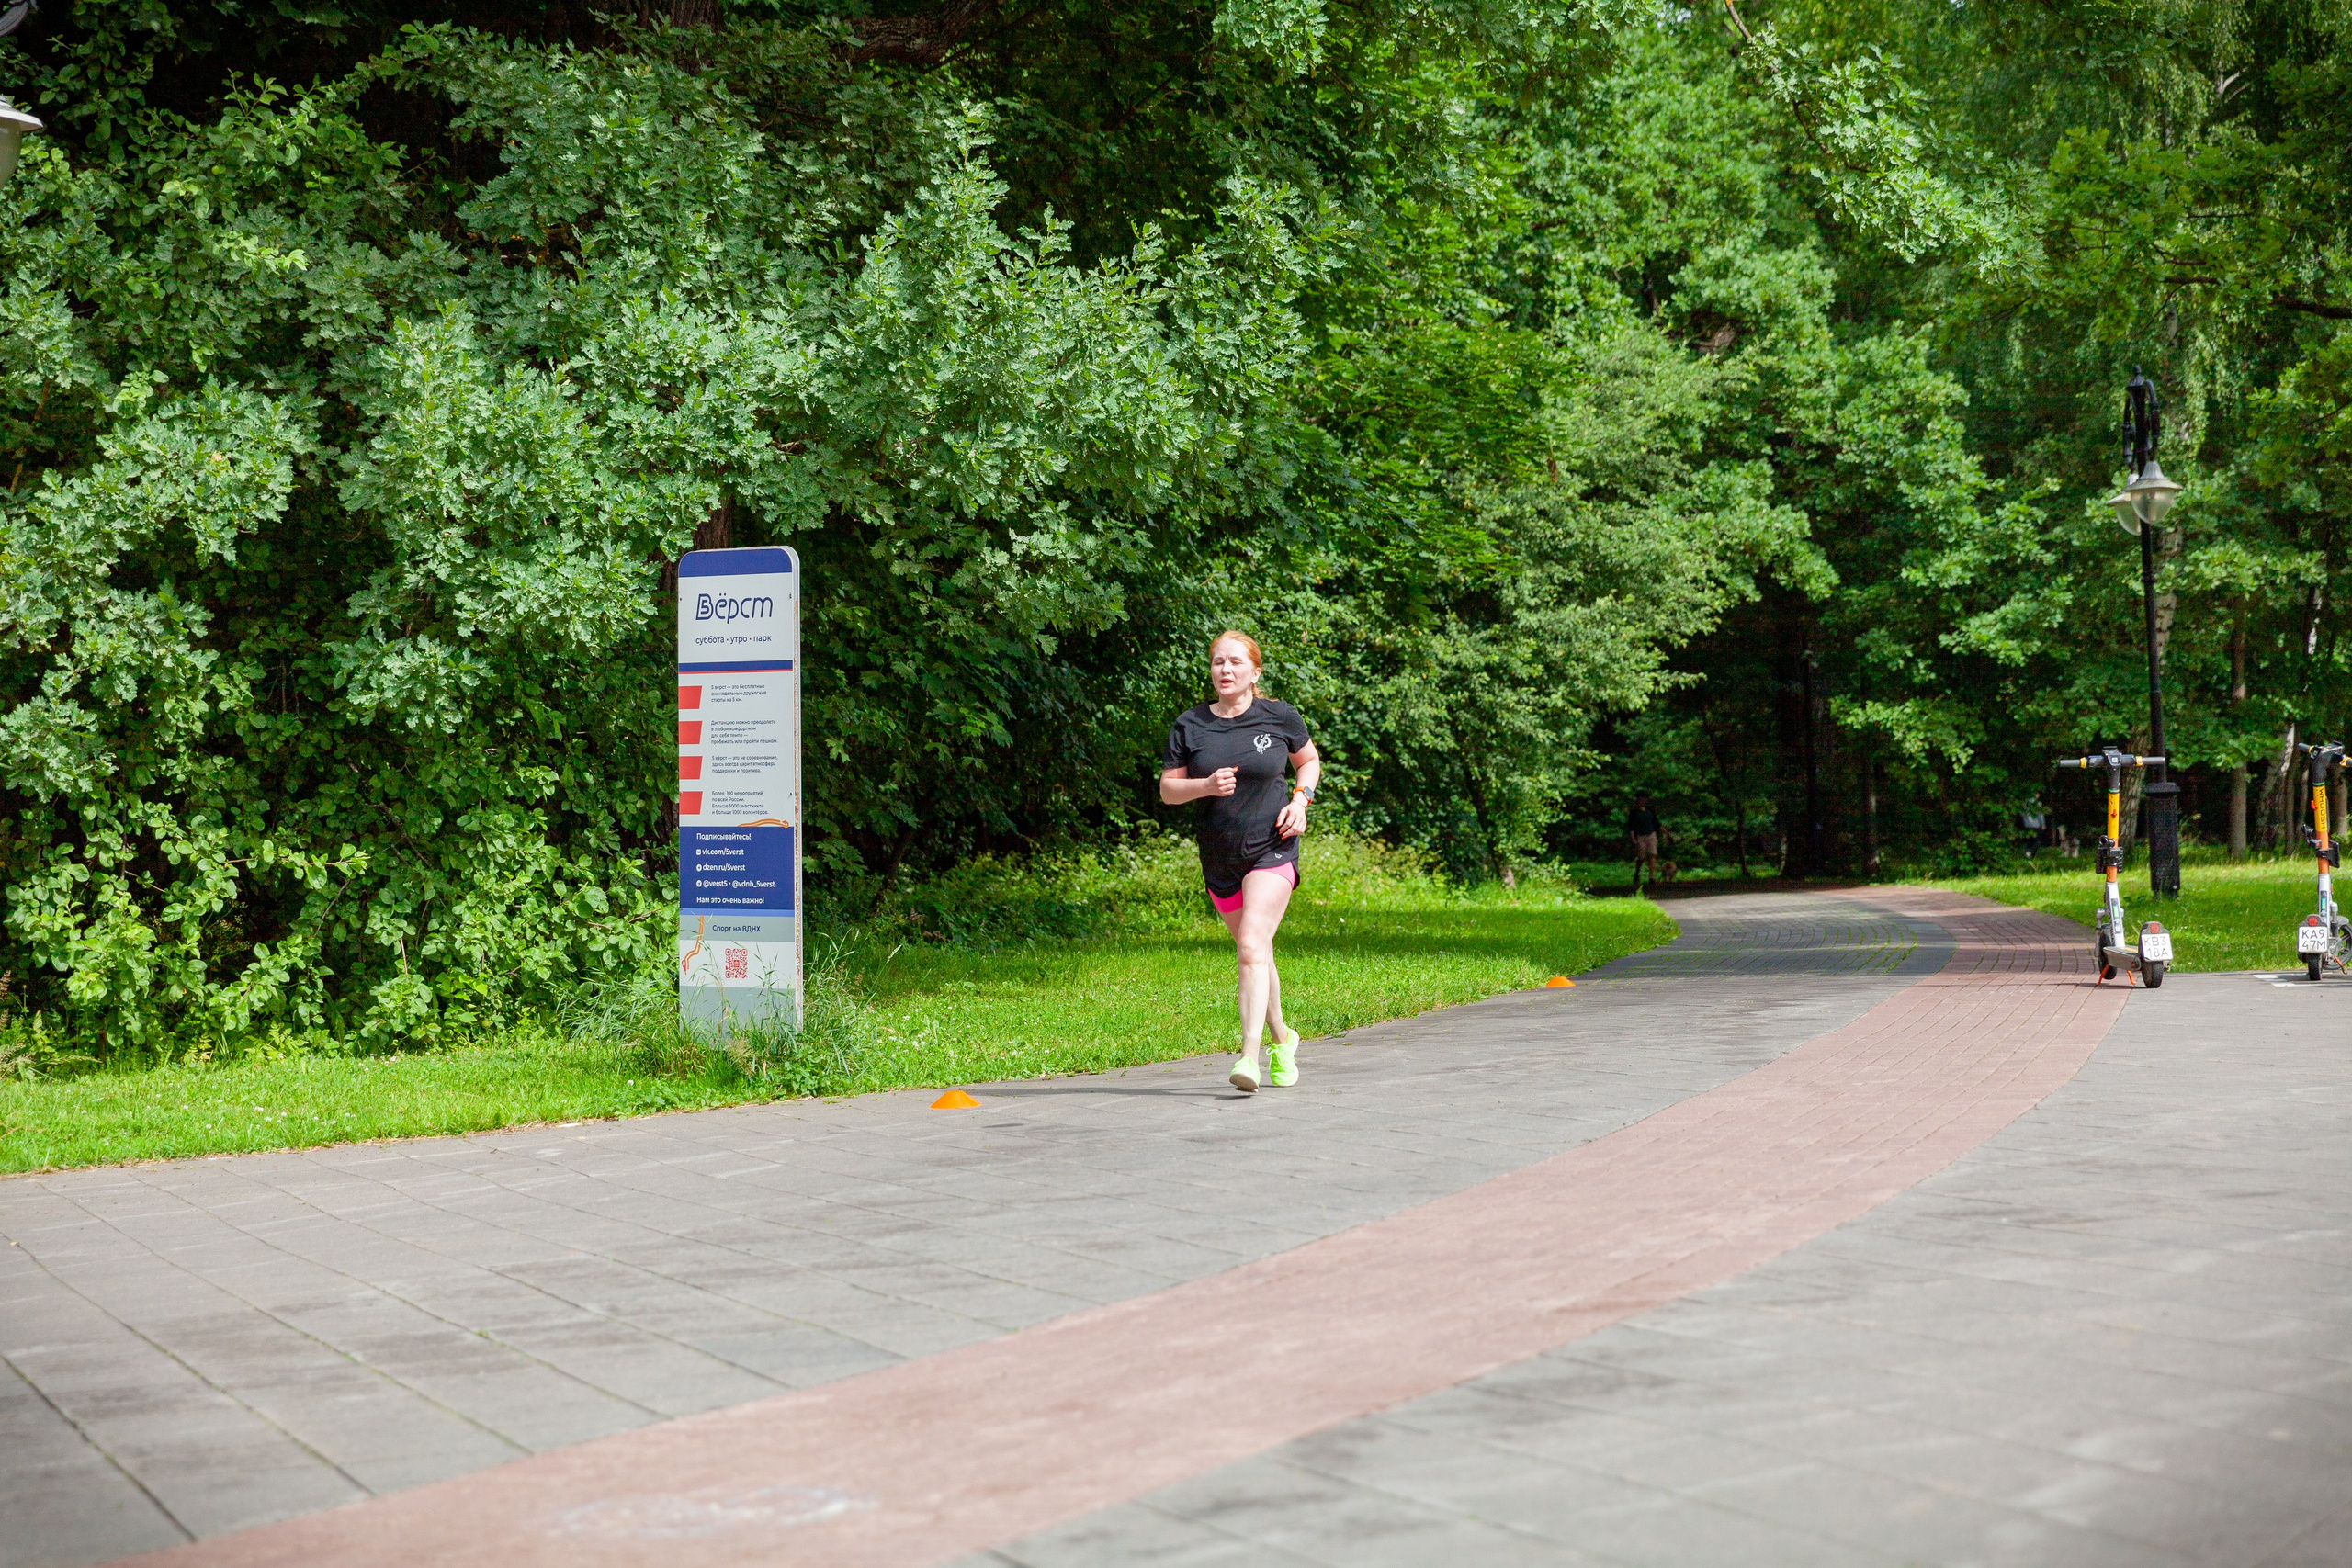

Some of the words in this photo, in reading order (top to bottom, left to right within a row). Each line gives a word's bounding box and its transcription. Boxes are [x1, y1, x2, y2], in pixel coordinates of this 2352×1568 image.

[696, 636, 724, 645] суббота
[702, 847, 744, 856] vk.com/5verst
[703, 880, 727, 888] @verst5
[732, 880, 775, 889] @vdnh_5verst
